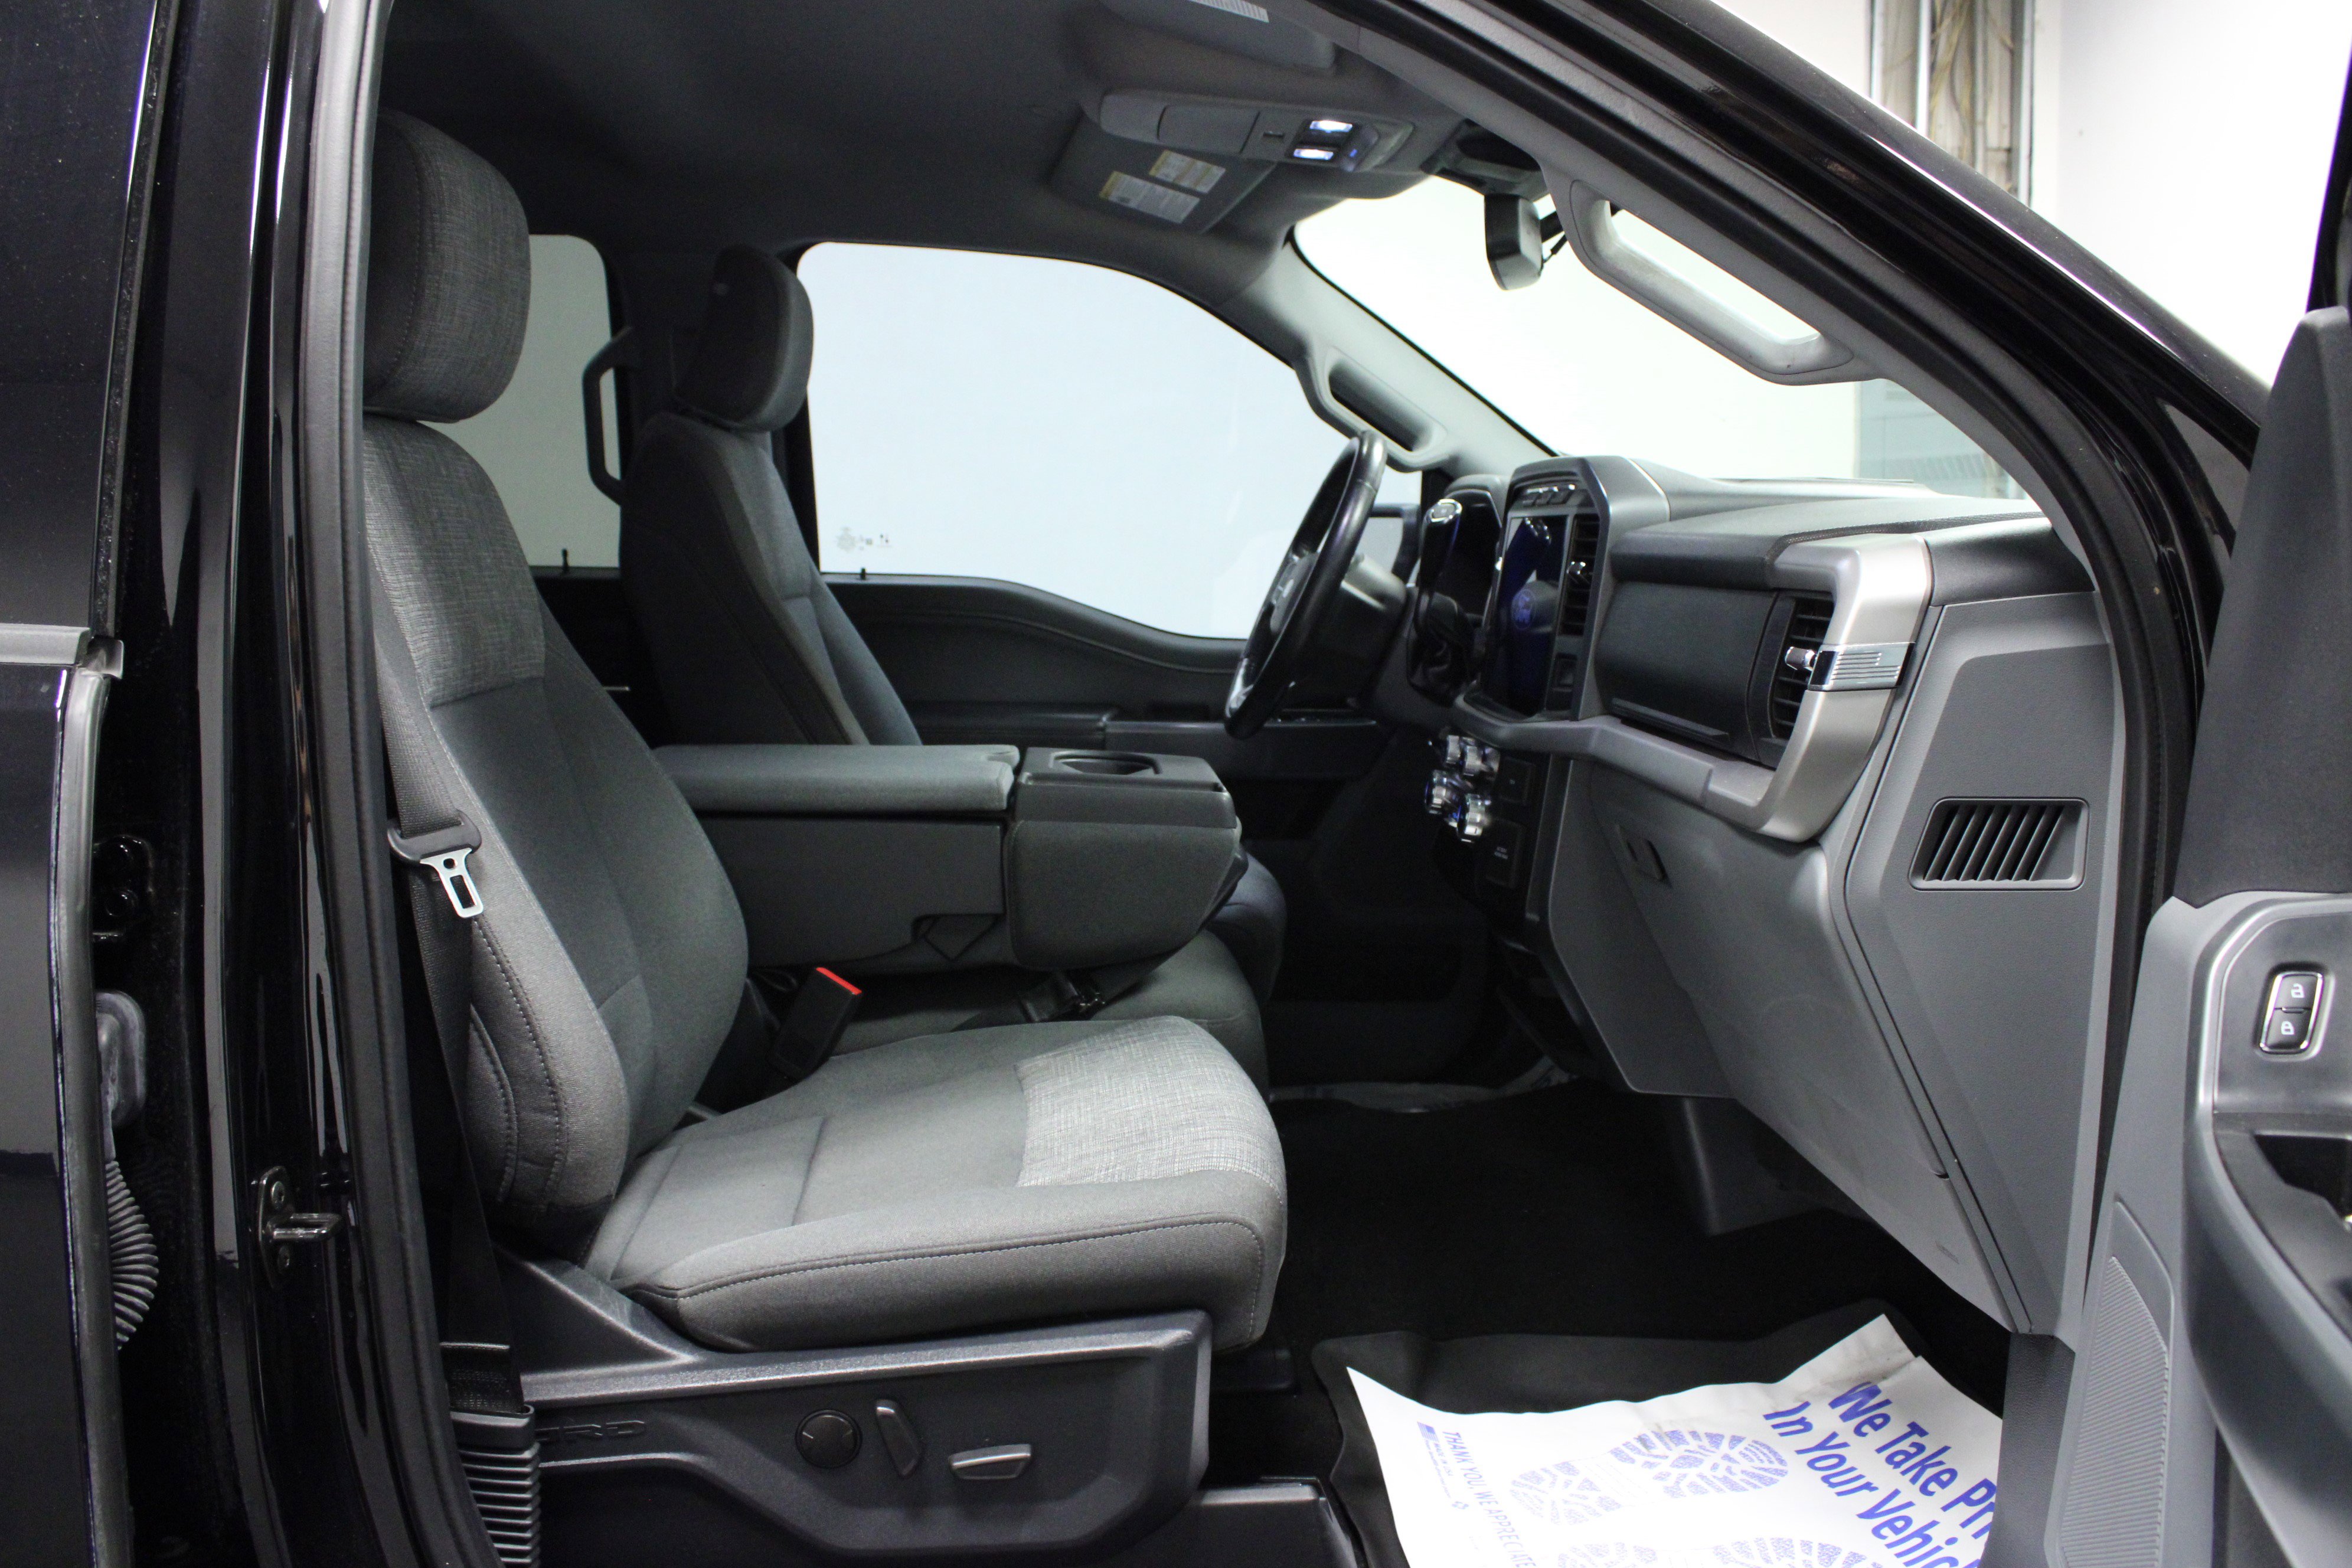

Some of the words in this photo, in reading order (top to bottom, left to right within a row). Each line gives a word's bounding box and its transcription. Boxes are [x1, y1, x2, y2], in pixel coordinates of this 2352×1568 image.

[1443, 1432, 1474, 1464] THANK
[1762, 1400, 1814, 1437] In
[1794, 1431, 1880, 1497] Your
[1828, 1381, 1893, 1438] We
[1874, 1421, 1958, 1497] Take
[1460, 1466, 1488, 1489] YOU,
[1474, 1491, 1499, 1506] WE
[1486, 1510, 1536, 1568] APPRECIATE
